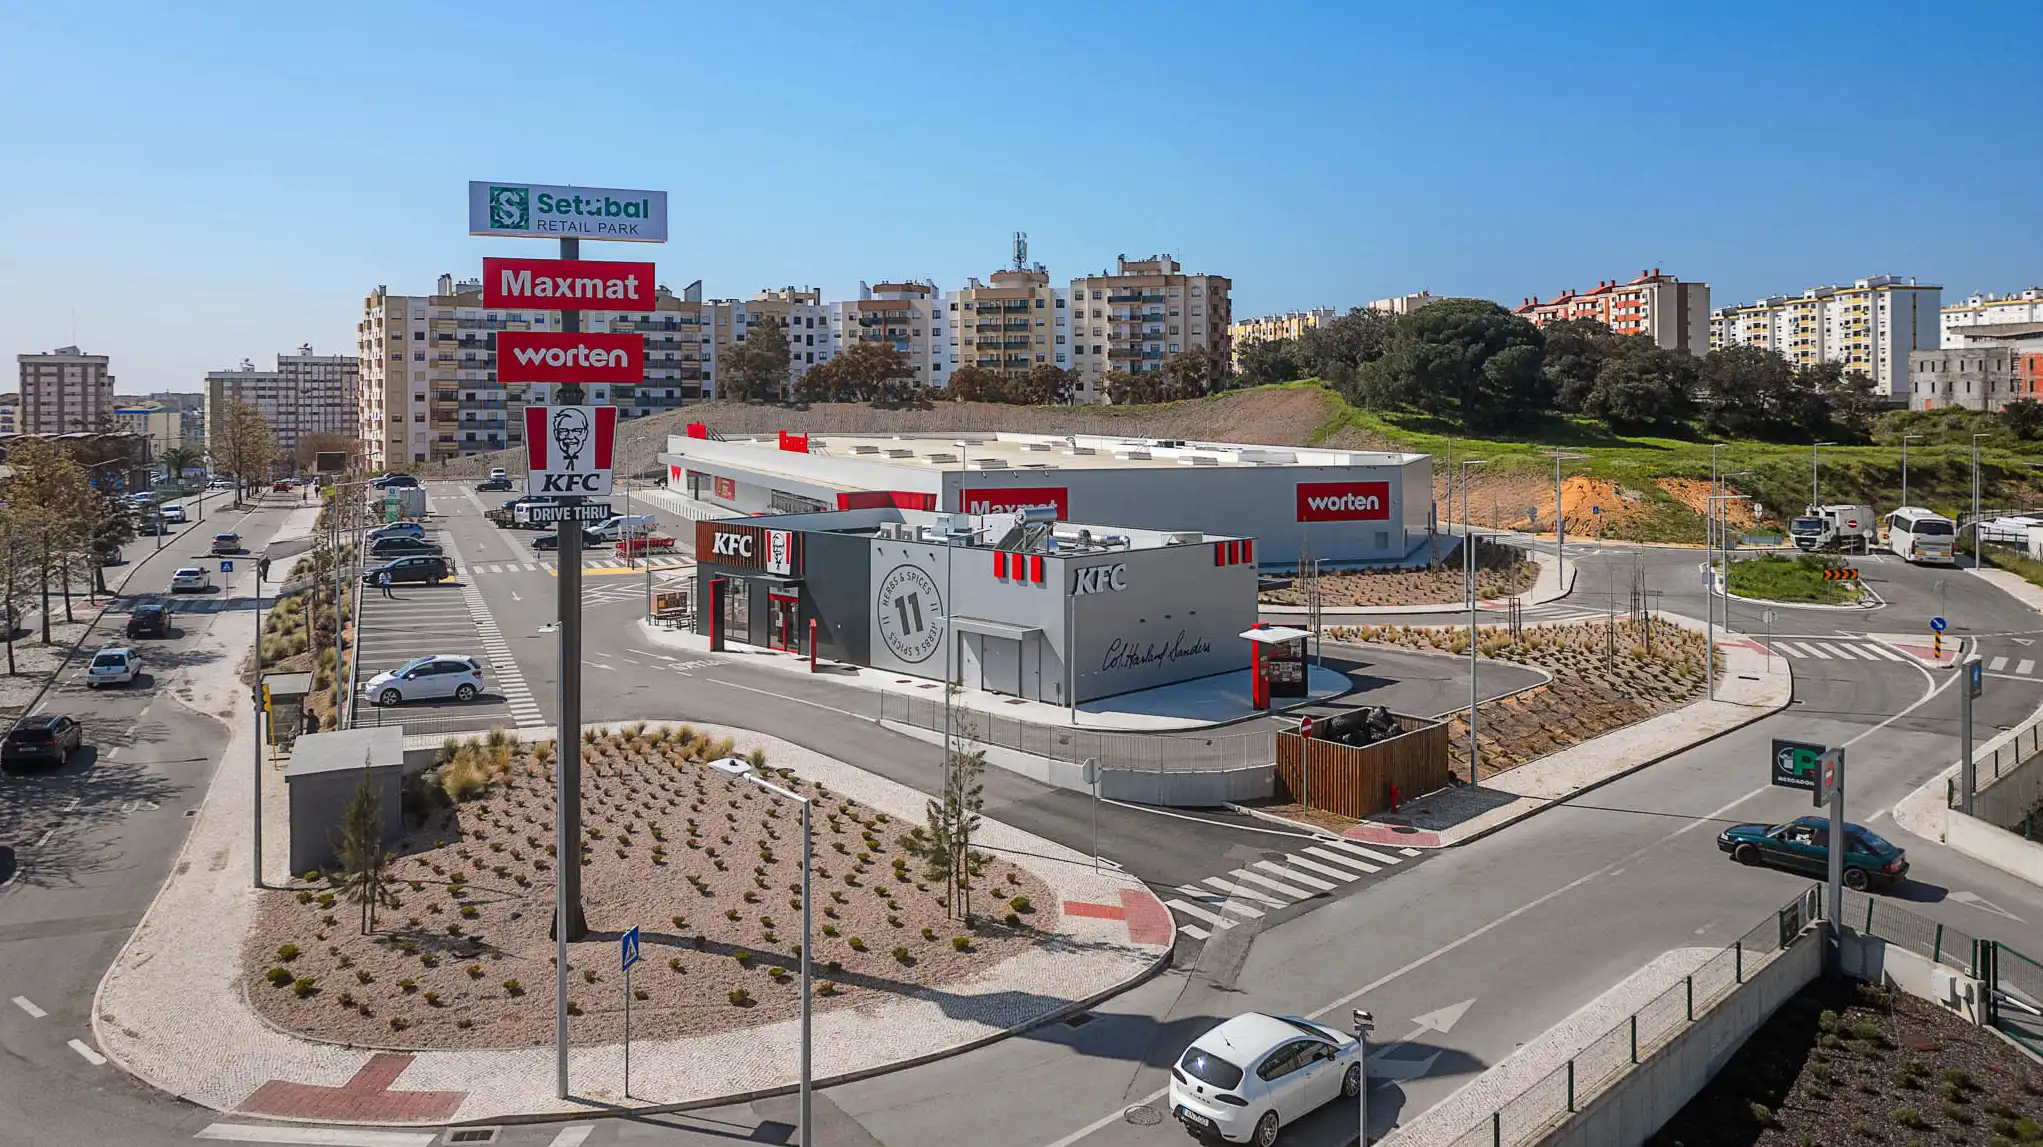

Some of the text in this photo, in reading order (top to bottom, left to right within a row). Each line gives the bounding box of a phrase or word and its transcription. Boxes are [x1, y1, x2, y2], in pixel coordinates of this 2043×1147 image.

[537, 219, 639, 235] RETAIL PARK
[501, 269, 639, 300] Maxmat
[513, 344, 628, 367] worten
[541, 473, 600, 492] KFC
[533, 506, 608, 521] DRIVE THRU
[1307, 492, 1379, 511] worten
[712, 532, 752, 558] KFC
[882, 571, 932, 607] HERBS & SPICES
[1073, 563, 1127, 596] KFC
[894, 591, 924, 636] 11
[888, 631, 913, 656] SPICES
[921, 622, 938, 652] HERBS
[1169, 629, 1211, 662] Sanders
